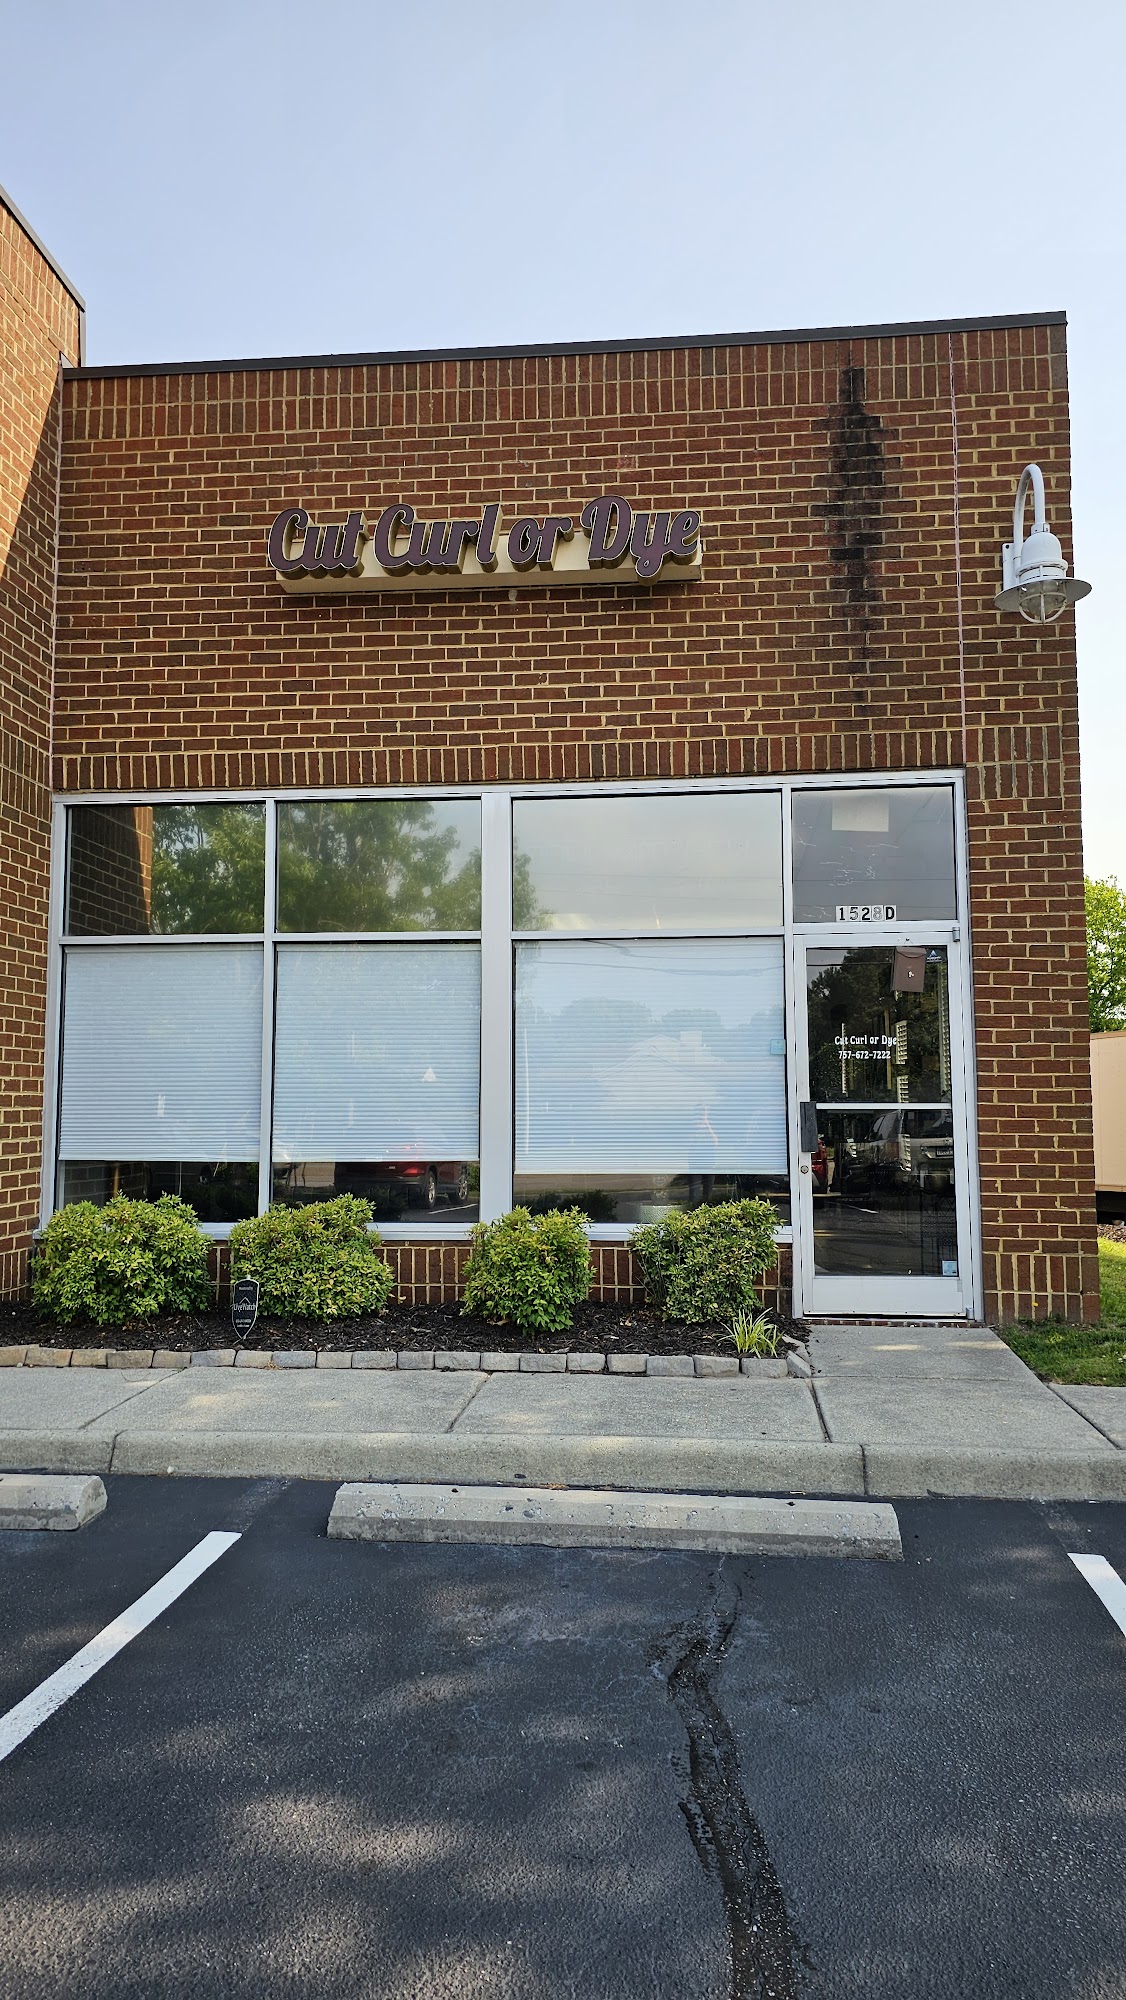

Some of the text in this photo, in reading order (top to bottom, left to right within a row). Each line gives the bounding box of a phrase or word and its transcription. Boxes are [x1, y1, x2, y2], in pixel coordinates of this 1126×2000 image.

[268, 495, 700, 578] Cut Curl or Dye
[838, 906, 895, 921] 1528D
[850, 1035, 868, 1046] Curl
[869, 1036, 880, 1045] or
[881, 1035, 897, 1048] Dye
[838, 1050, 891, 1060] 757-672-7222
